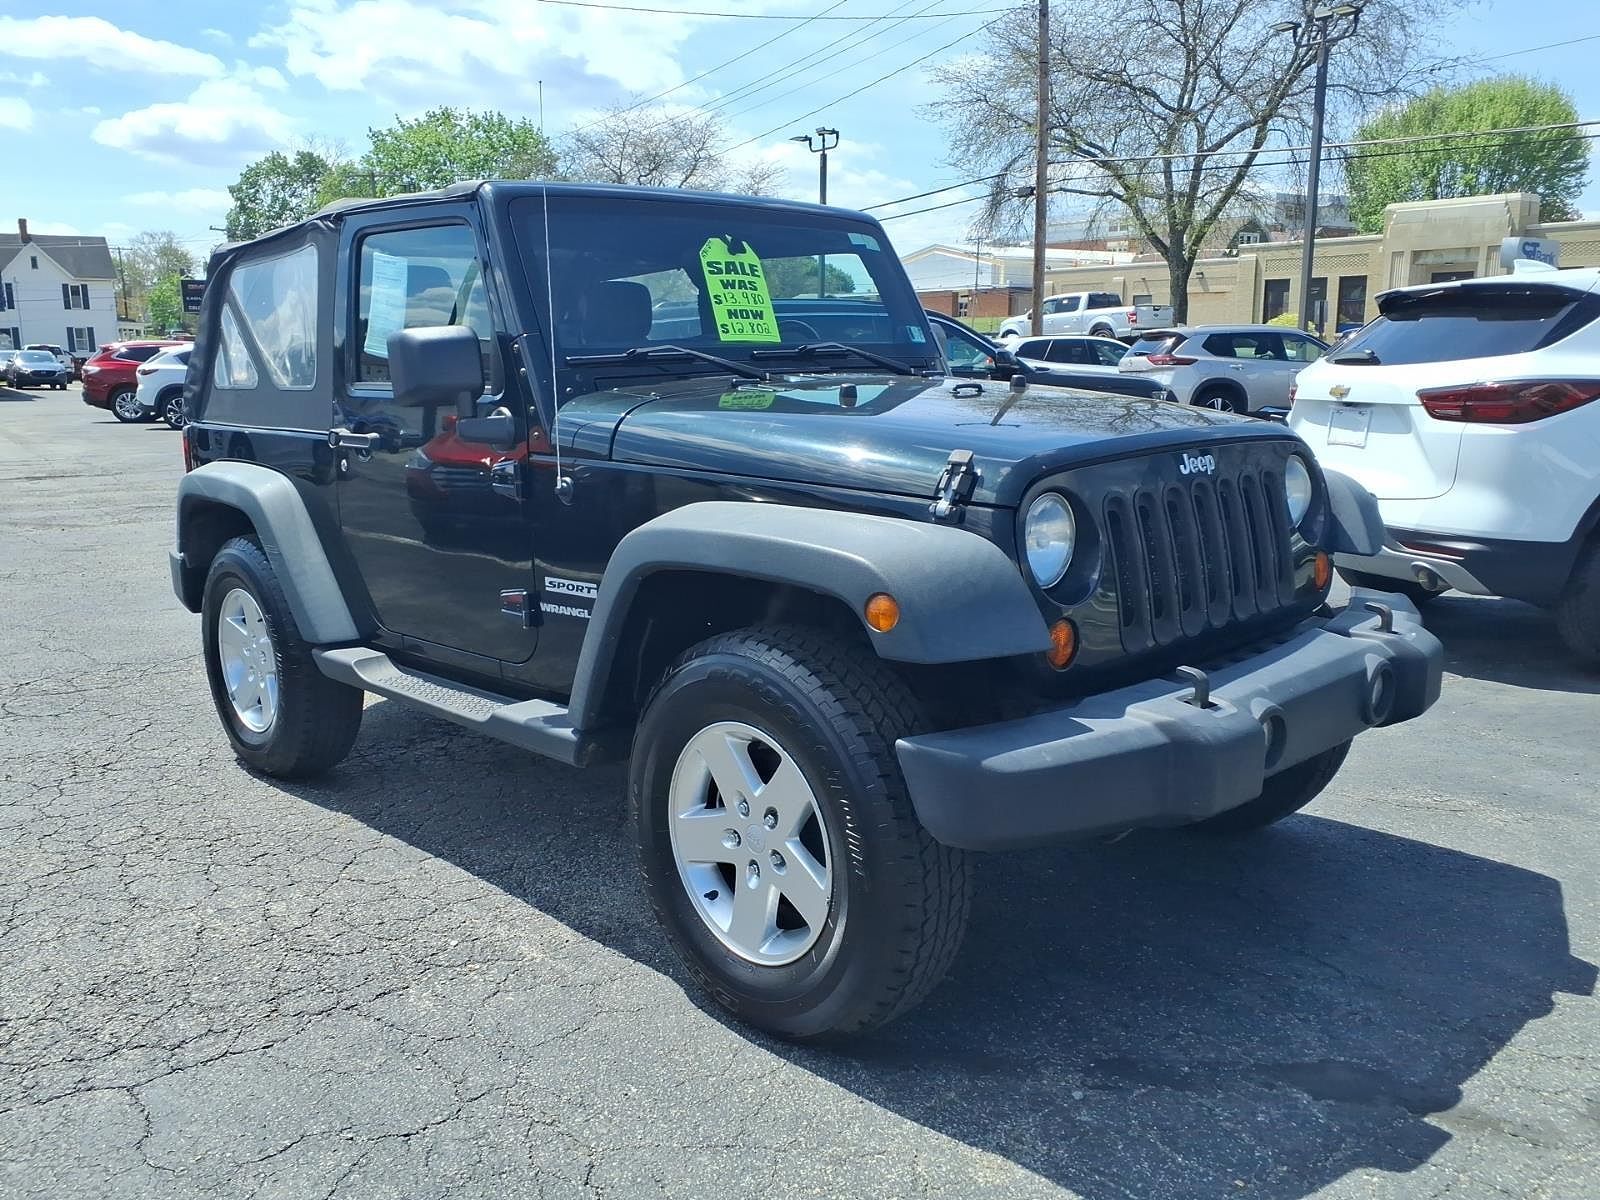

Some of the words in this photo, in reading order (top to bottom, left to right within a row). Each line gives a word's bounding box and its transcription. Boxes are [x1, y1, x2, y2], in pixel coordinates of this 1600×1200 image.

[706, 261, 760, 278] SALE
[720, 280, 758, 291] WAS
[727, 309, 764, 320] NOW
[1179, 453, 1216, 475] Jeep
[548, 580, 597, 594] SPORT
[540, 602, 592, 619] WRANGL
